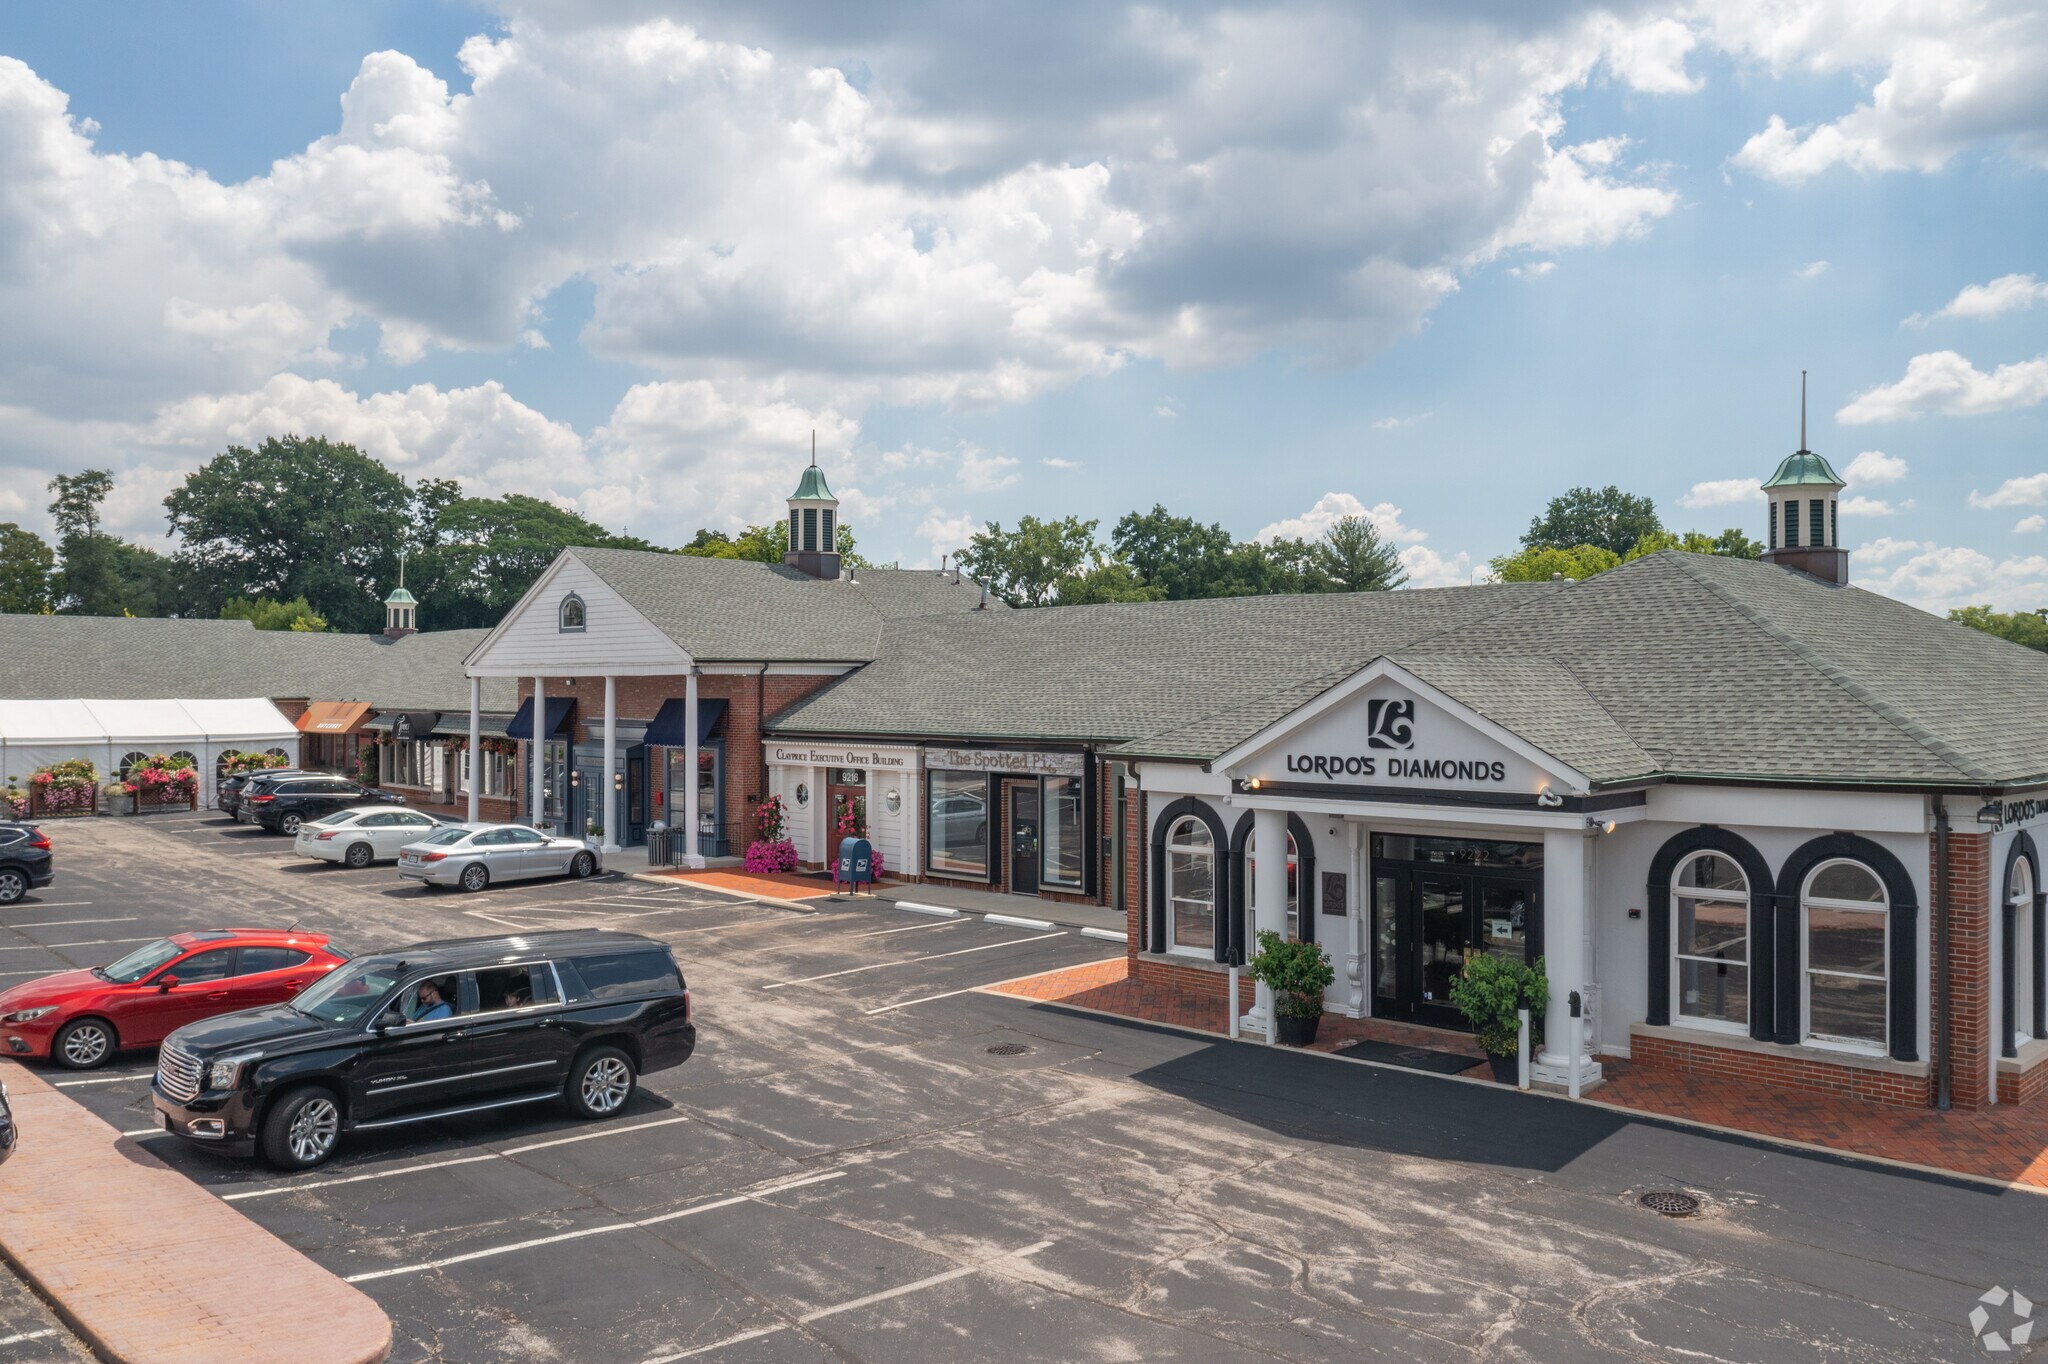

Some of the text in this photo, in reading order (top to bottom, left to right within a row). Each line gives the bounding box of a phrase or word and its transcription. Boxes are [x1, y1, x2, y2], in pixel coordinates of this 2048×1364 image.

[776, 748, 904, 766] CLAYPRICE EXECUTIVE OFFICE BUILDING
[947, 750, 971, 766] The
[974, 751, 1028, 769] Spotted
[1287, 754, 1505, 781] LORDO'S DIAMONDS
[842, 772, 859, 782] 9216
